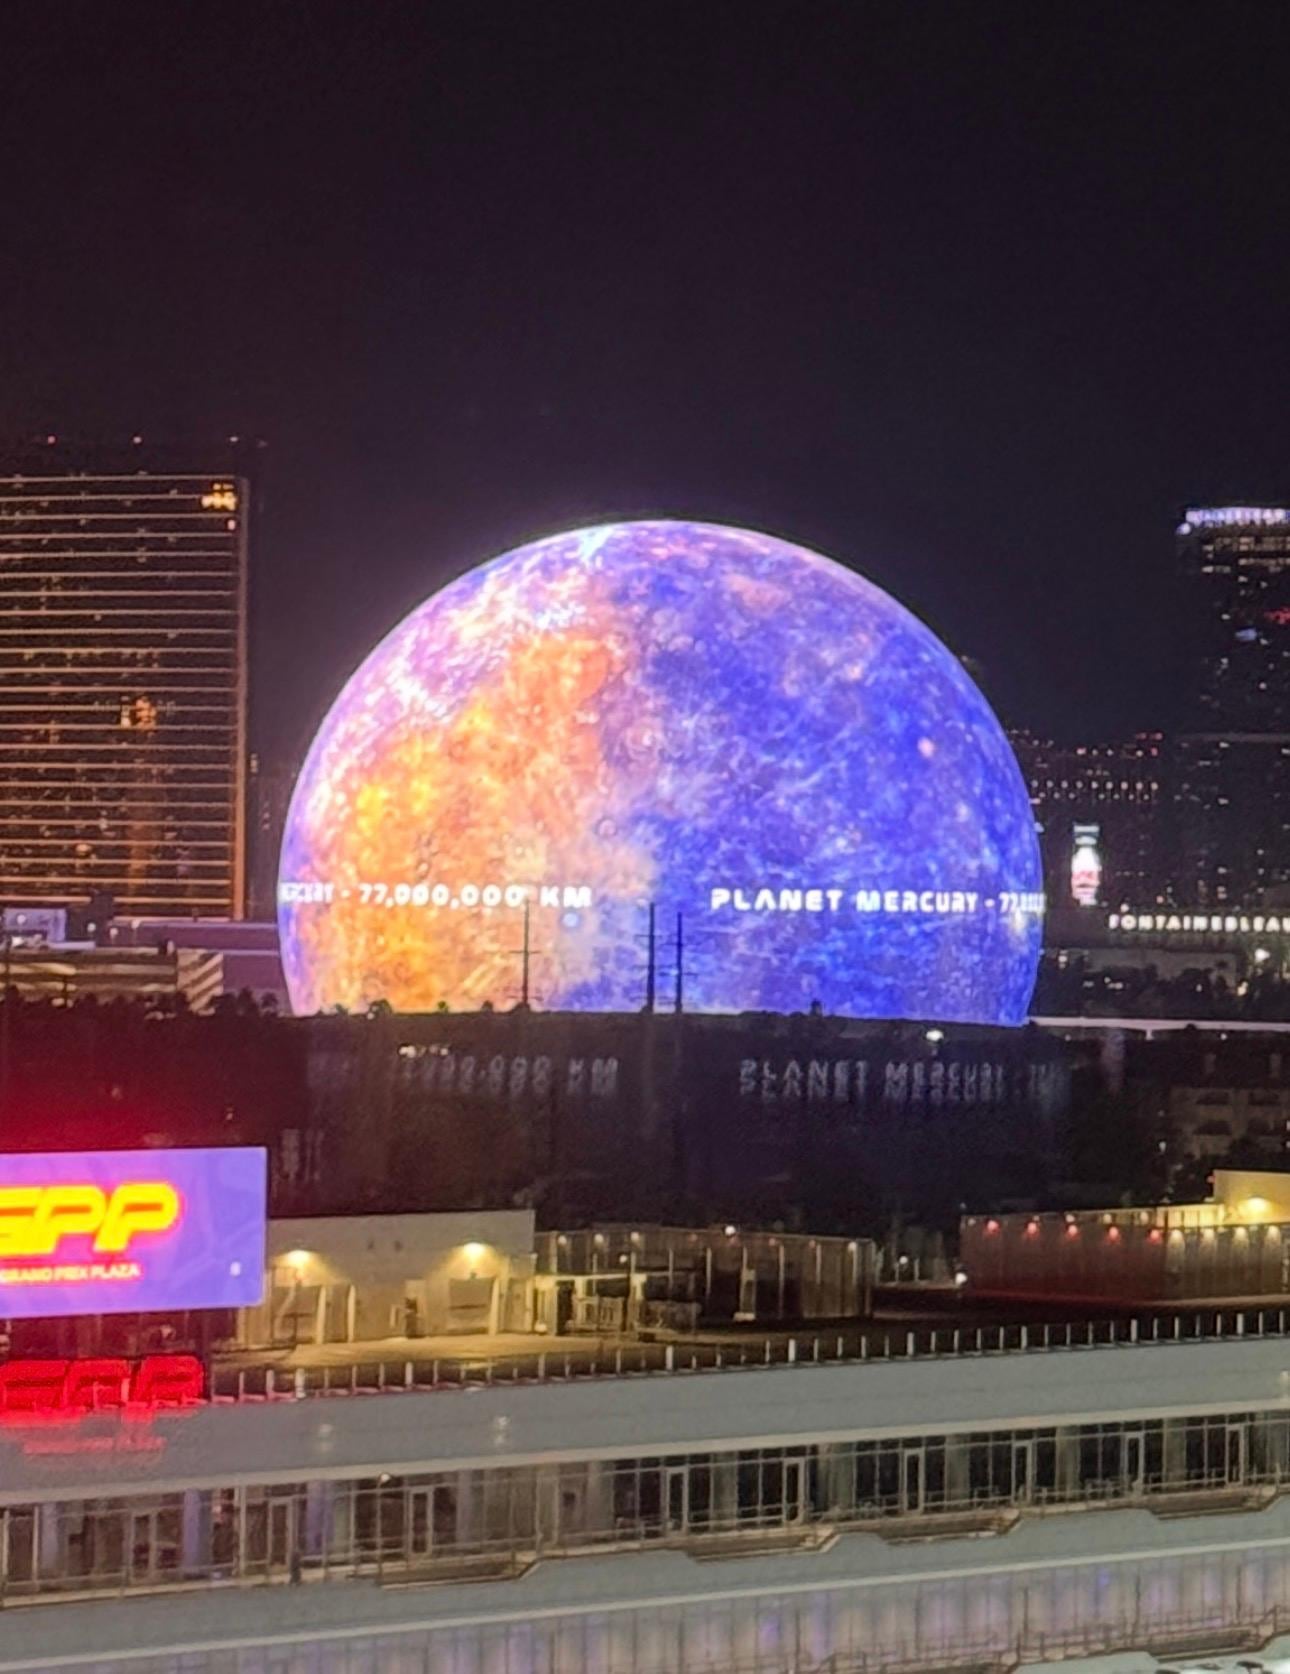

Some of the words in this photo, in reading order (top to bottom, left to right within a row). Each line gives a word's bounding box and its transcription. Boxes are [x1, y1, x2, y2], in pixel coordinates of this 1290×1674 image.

[540, 885, 592, 908] KM
[711, 888, 843, 912] PLANET
[855, 890, 978, 913] MERCURY
[90, 1263, 140, 1279] PLAZA
